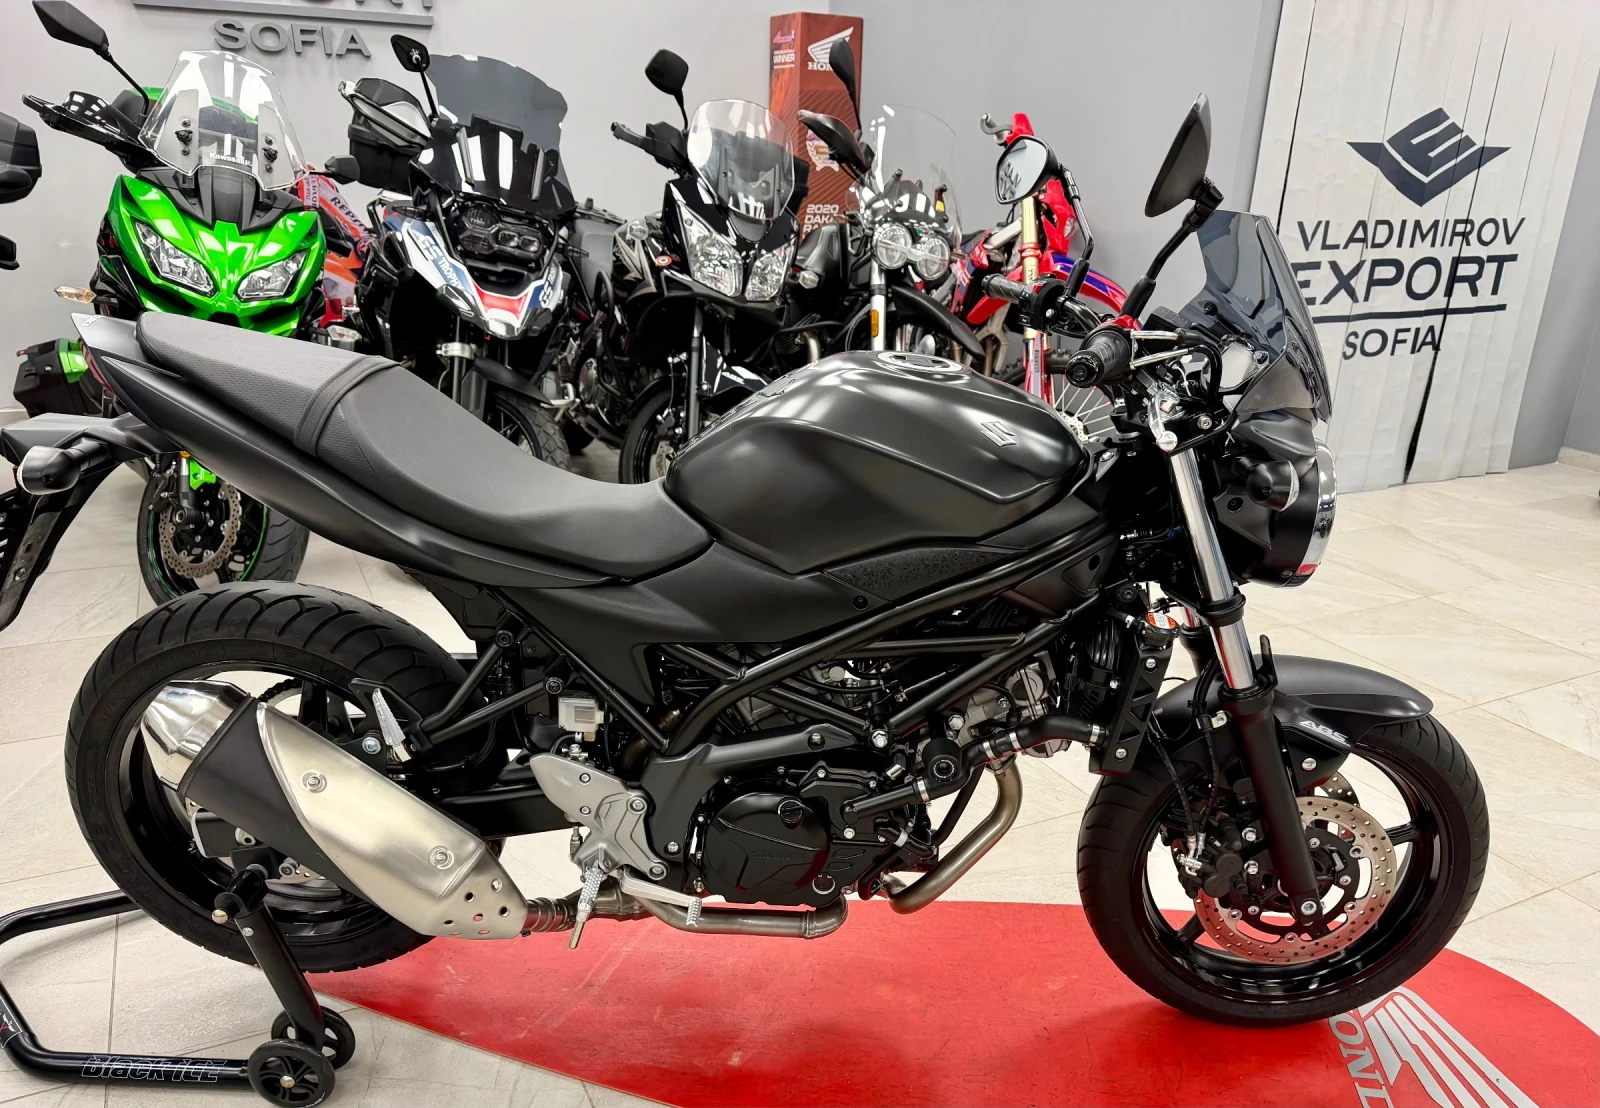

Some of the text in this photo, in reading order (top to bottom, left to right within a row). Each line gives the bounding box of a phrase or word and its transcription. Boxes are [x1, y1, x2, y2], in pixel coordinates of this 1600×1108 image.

[213, 18, 371, 57] SOFIA
[807, 61, 835, 71] HON
[210, 152, 252, 166] Kawasaki
[806, 203, 840, 214] 2020
[1297, 217, 1526, 251] VLADIMIROV
[416, 234, 464, 290] GS TROPHY
[1291, 253, 1519, 306] EXPORT
[1342, 325, 1441, 361] SOFIA
